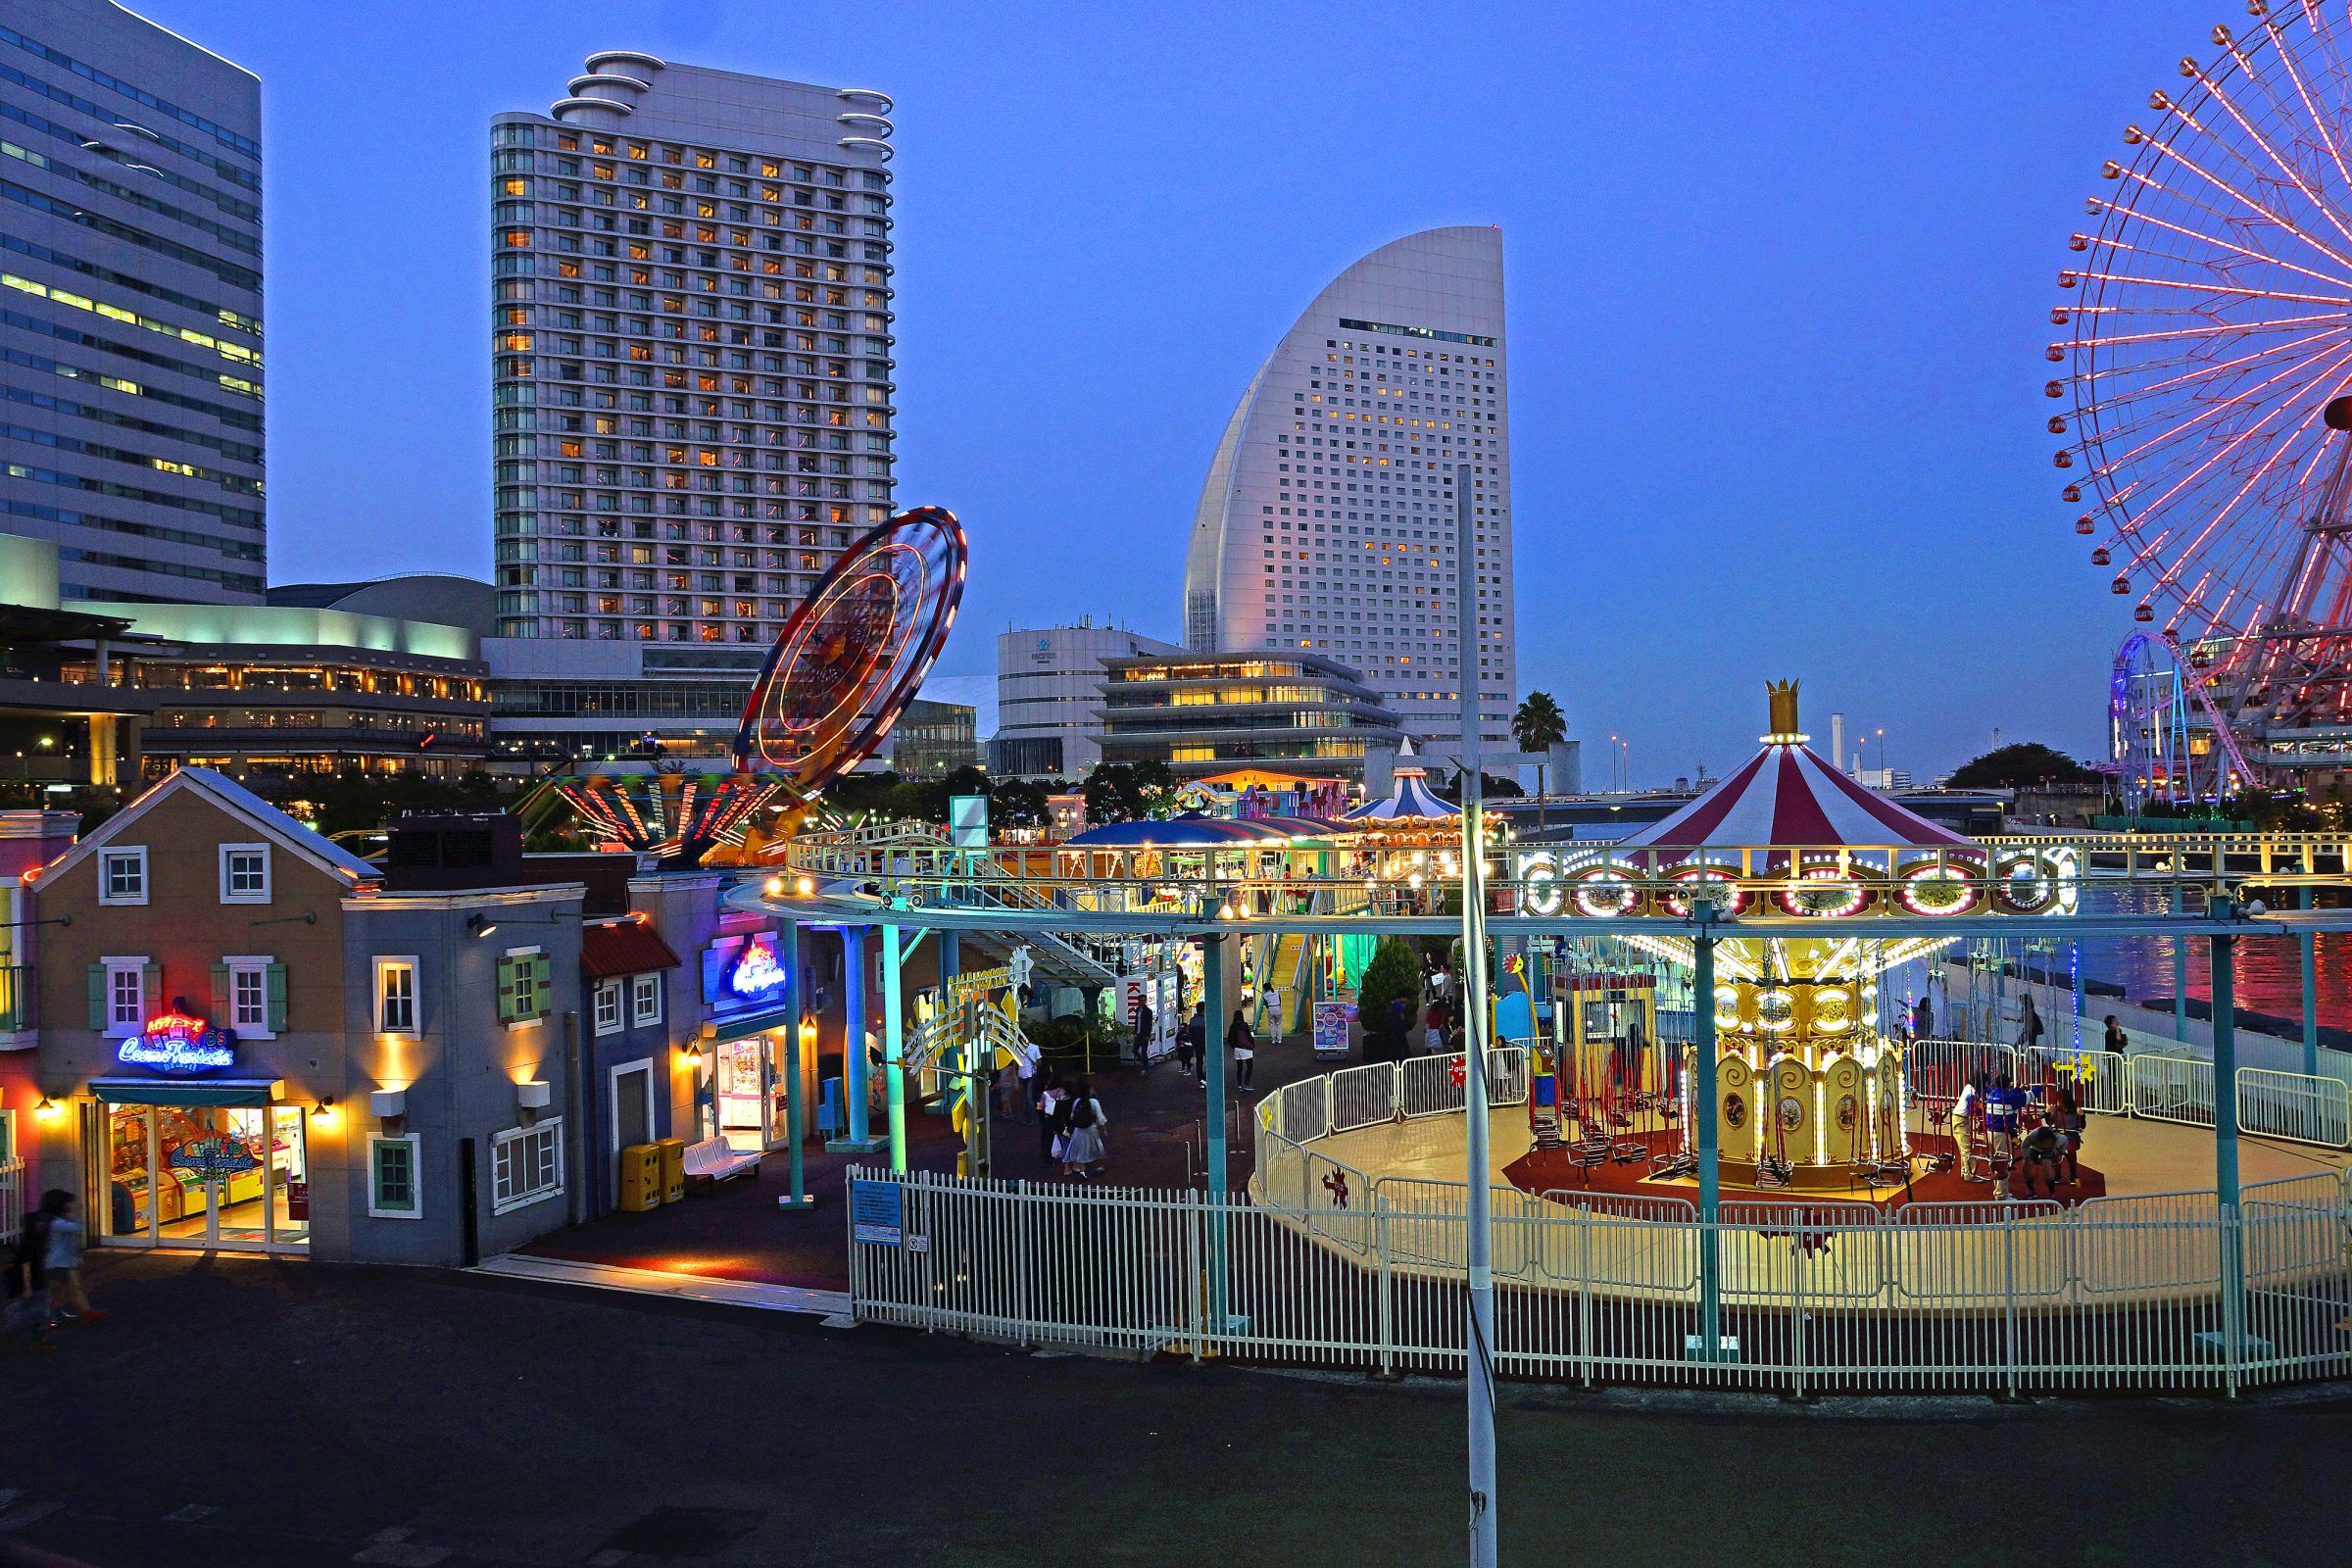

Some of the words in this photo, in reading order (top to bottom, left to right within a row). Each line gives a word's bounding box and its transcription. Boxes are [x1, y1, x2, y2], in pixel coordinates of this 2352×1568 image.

[1127, 982, 1142, 1028] KIRI
[118, 1036, 171, 1061] Cosmo
[190, 1030, 226, 1047] KIDS
[220, 1142, 250, 1154] KIDS
